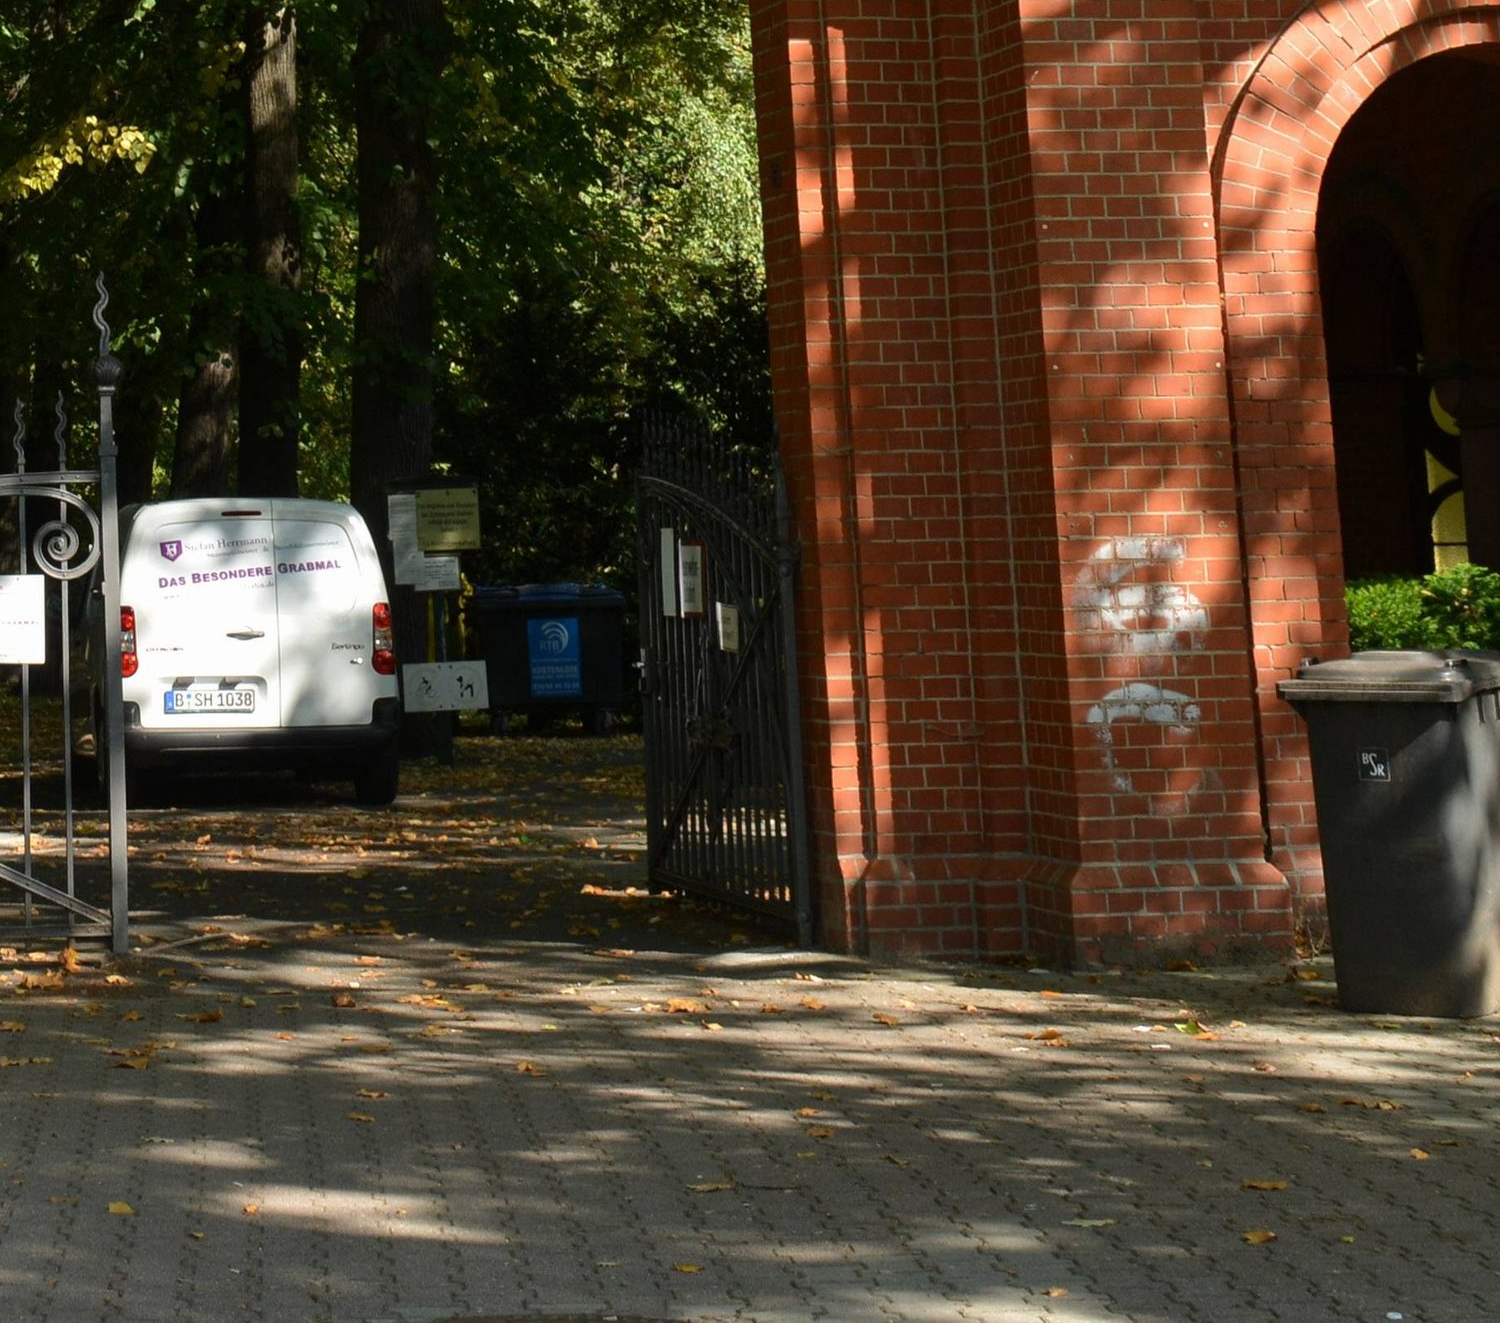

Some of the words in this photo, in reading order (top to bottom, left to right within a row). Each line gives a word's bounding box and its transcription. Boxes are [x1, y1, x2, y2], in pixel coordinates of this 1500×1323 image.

[217, 536, 269, 550] Herrmann
[540, 640, 561, 652] RTB
[175, 693, 184, 707] B
[194, 692, 213, 707] SH
[217, 692, 253, 707] 1038
